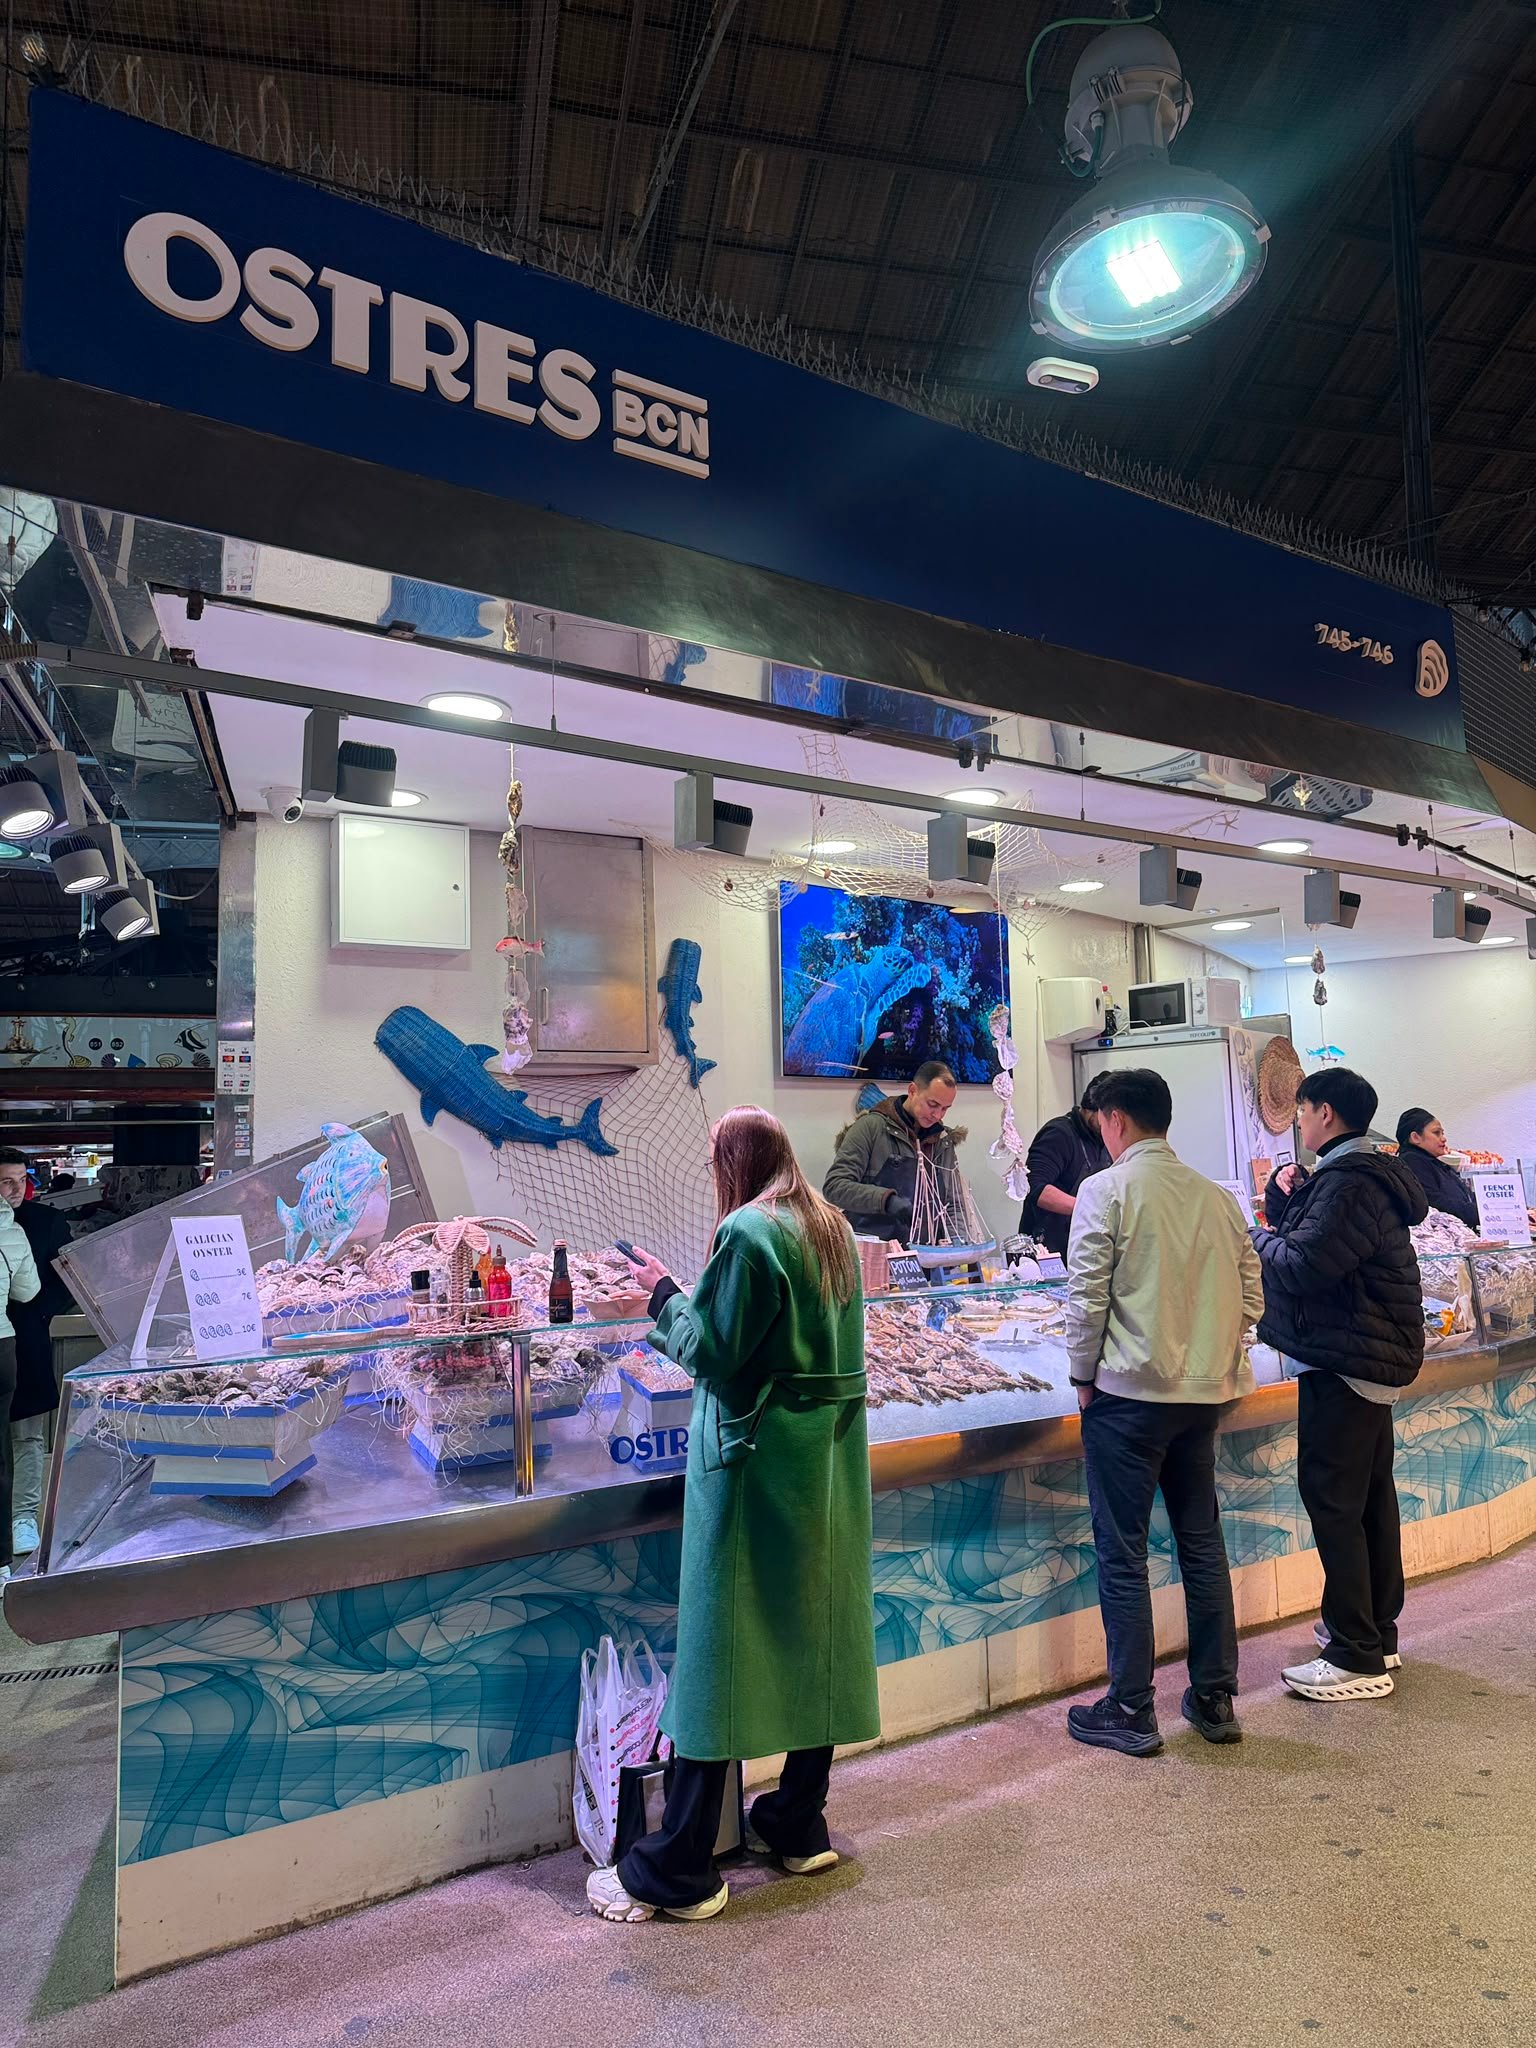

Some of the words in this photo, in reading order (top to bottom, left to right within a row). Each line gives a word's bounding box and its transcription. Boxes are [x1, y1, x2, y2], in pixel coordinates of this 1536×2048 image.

[124, 212, 600, 441] OSTRES
[612, 388, 710, 460] BCN
[1314, 623, 1394, 665] 745-746
[185, 1233, 234, 1245] GALICIAN
[193, 1246, 233, 1259] OYSTER
[236, 1268, 246, 1276] 3€
[890, 1257, 921, 1275] POTÓN
[241, 1291, 252, 1301] 7€
[241, 1323, 256, 1333] 10€
[610, 1427, 689, 1464] OSTR
